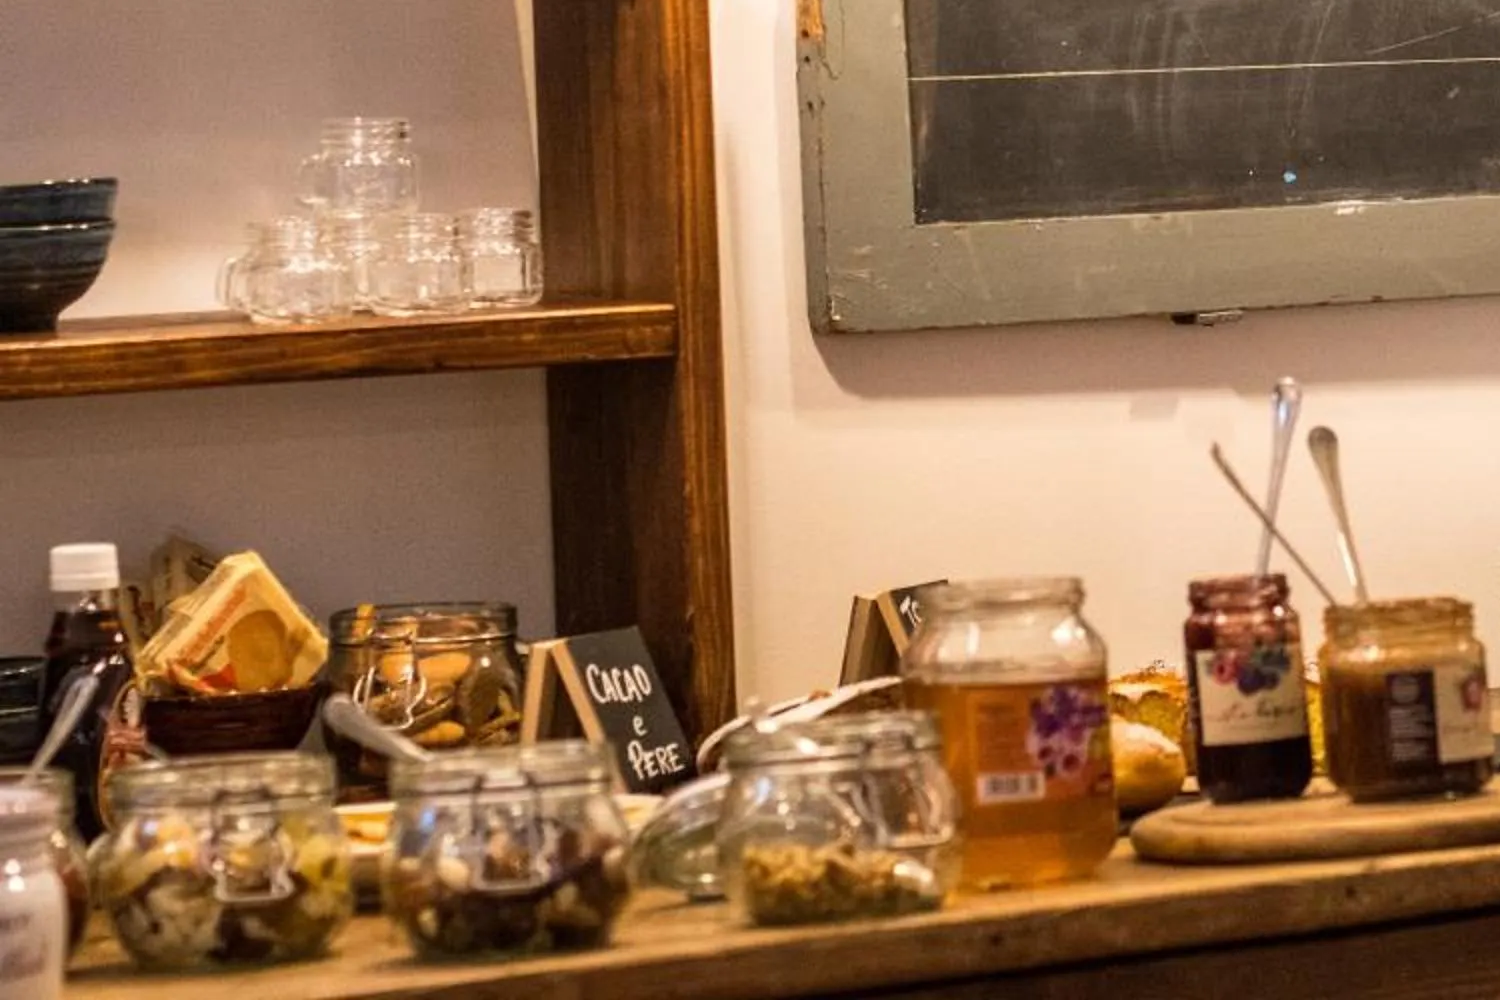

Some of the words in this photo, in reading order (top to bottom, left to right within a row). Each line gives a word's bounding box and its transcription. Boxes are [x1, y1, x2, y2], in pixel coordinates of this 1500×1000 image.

[586, 663, 652, 704] CACAO
[632, 715, 647, 737] e
[627, 740, 685, 780] PERE
